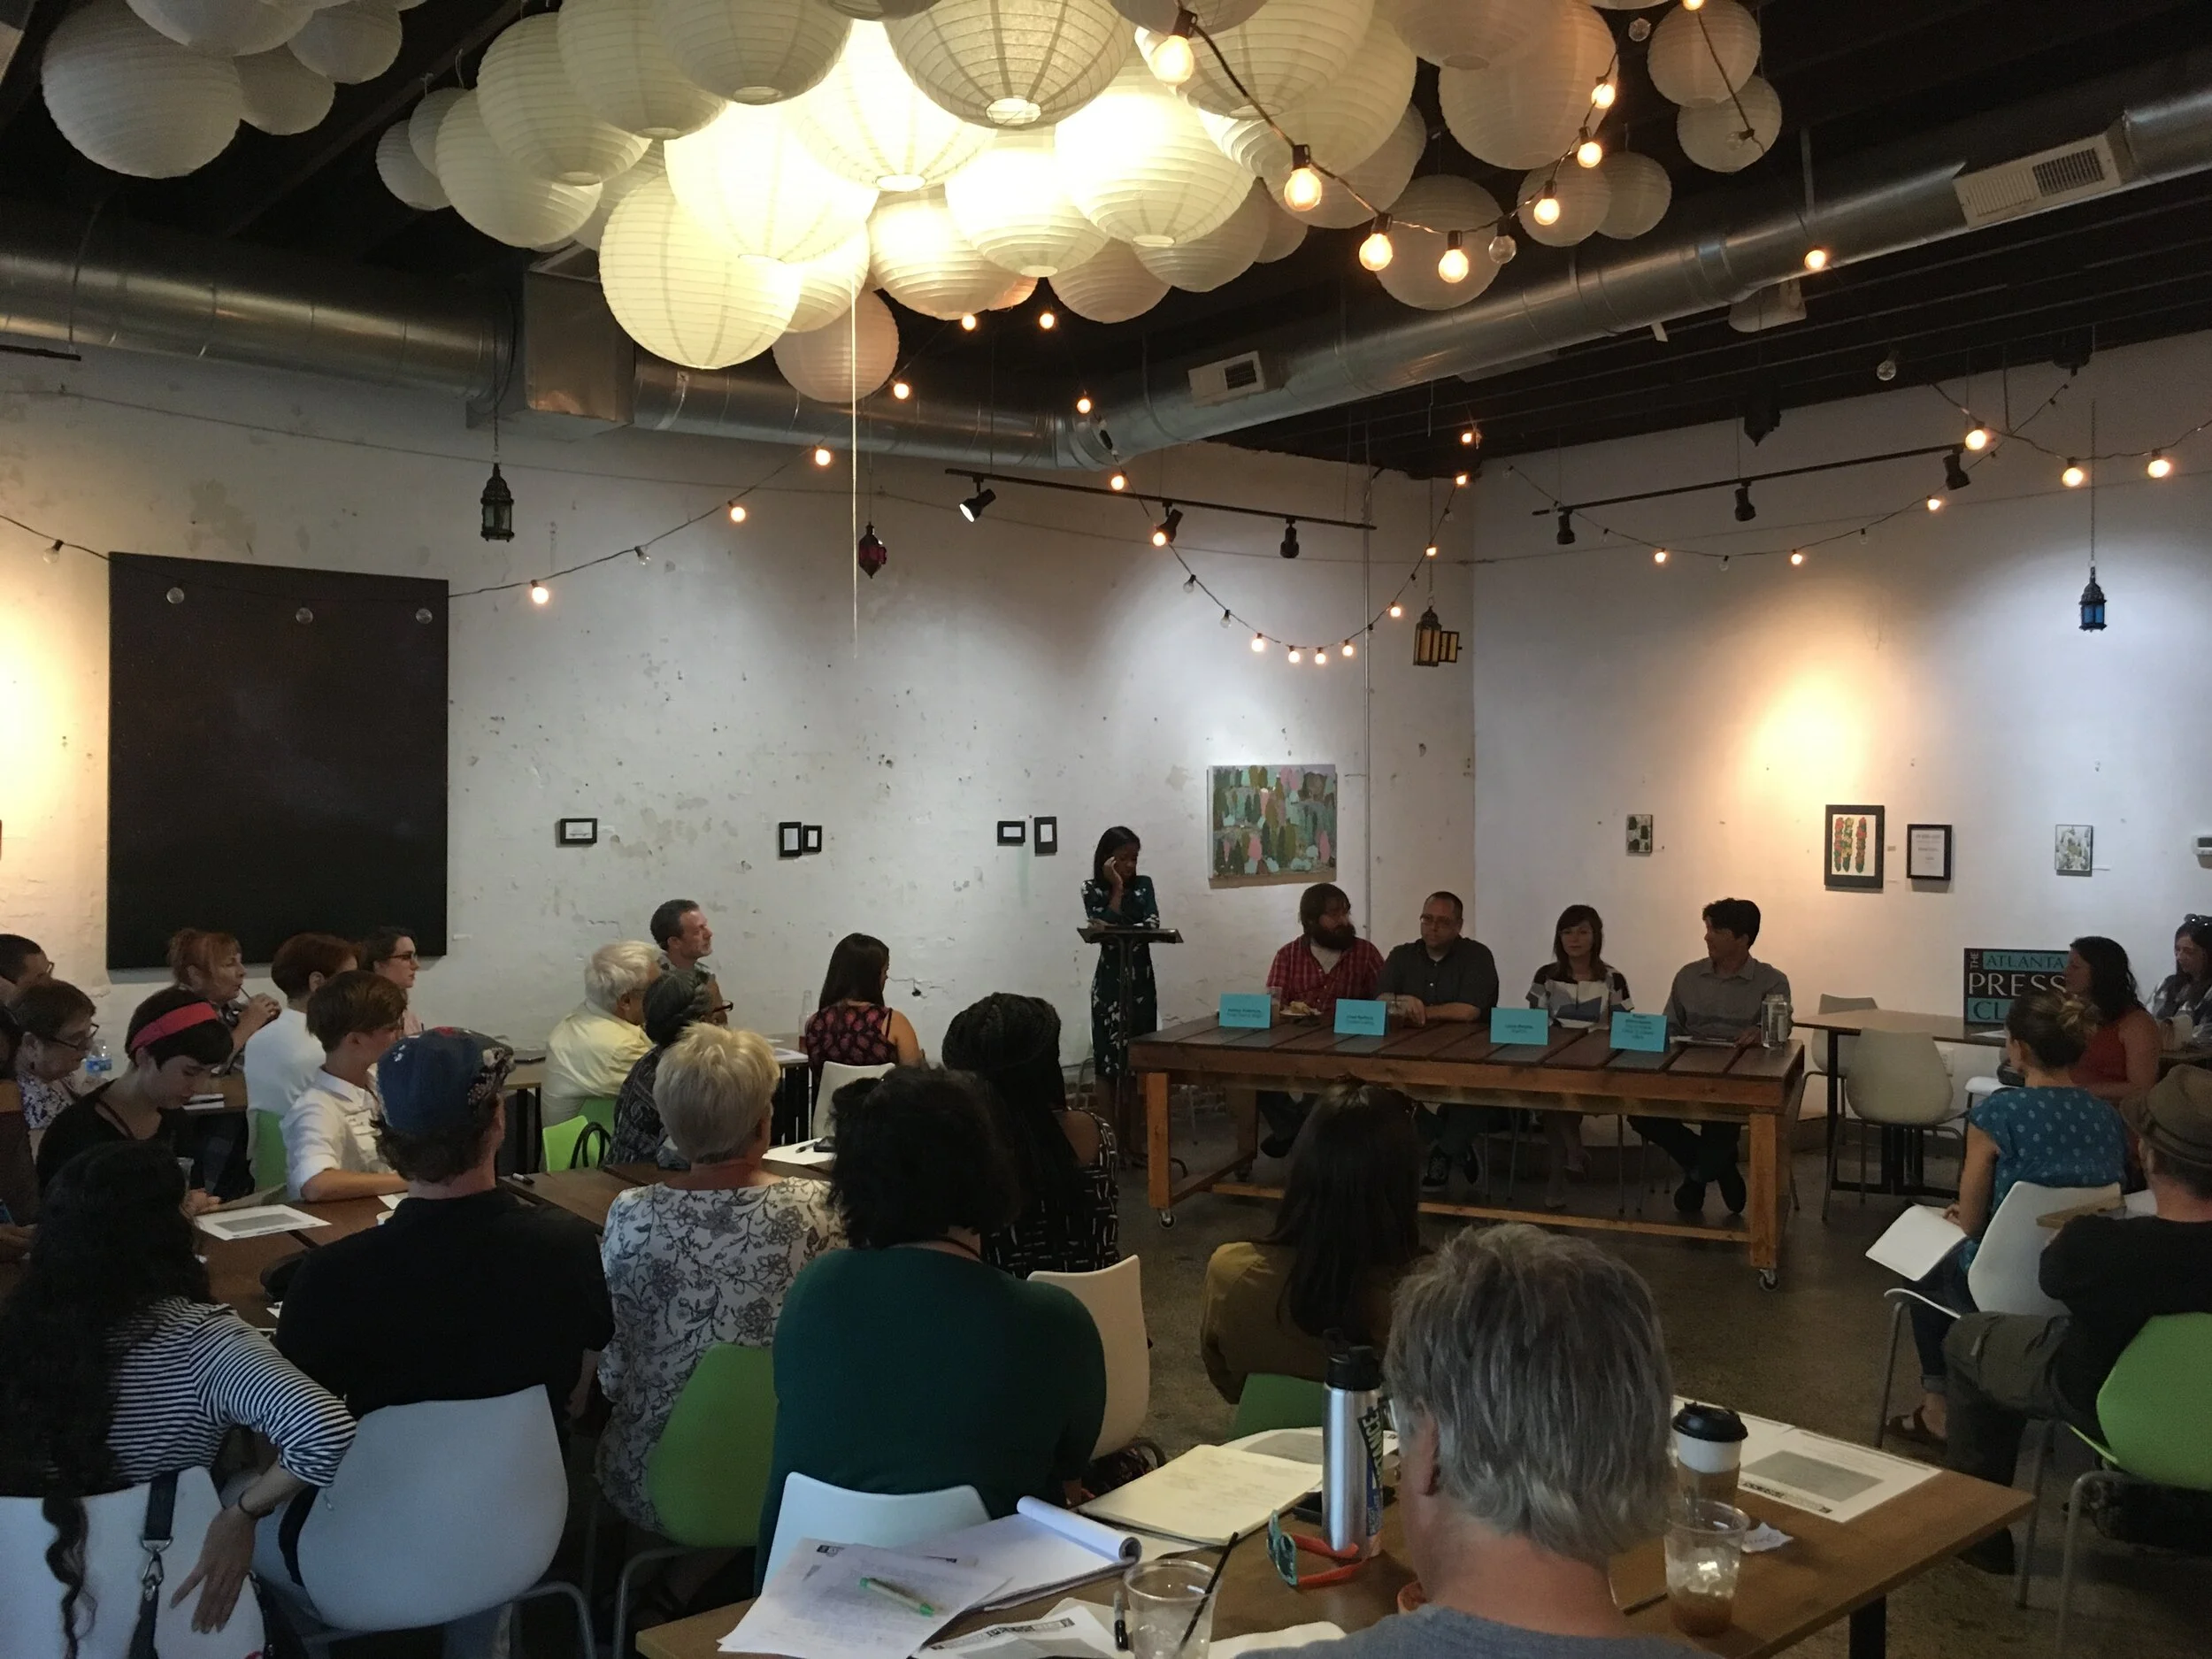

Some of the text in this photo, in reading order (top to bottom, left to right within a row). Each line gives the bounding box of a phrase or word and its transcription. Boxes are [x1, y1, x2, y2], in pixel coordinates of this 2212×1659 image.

[1970, 951, 1979, 970] THE
[1985, 955, 2064, 970] ATLANTA
[1968, 972, 2068, 997] PRESS
[1972, 1000, 2006, 1021] CL
